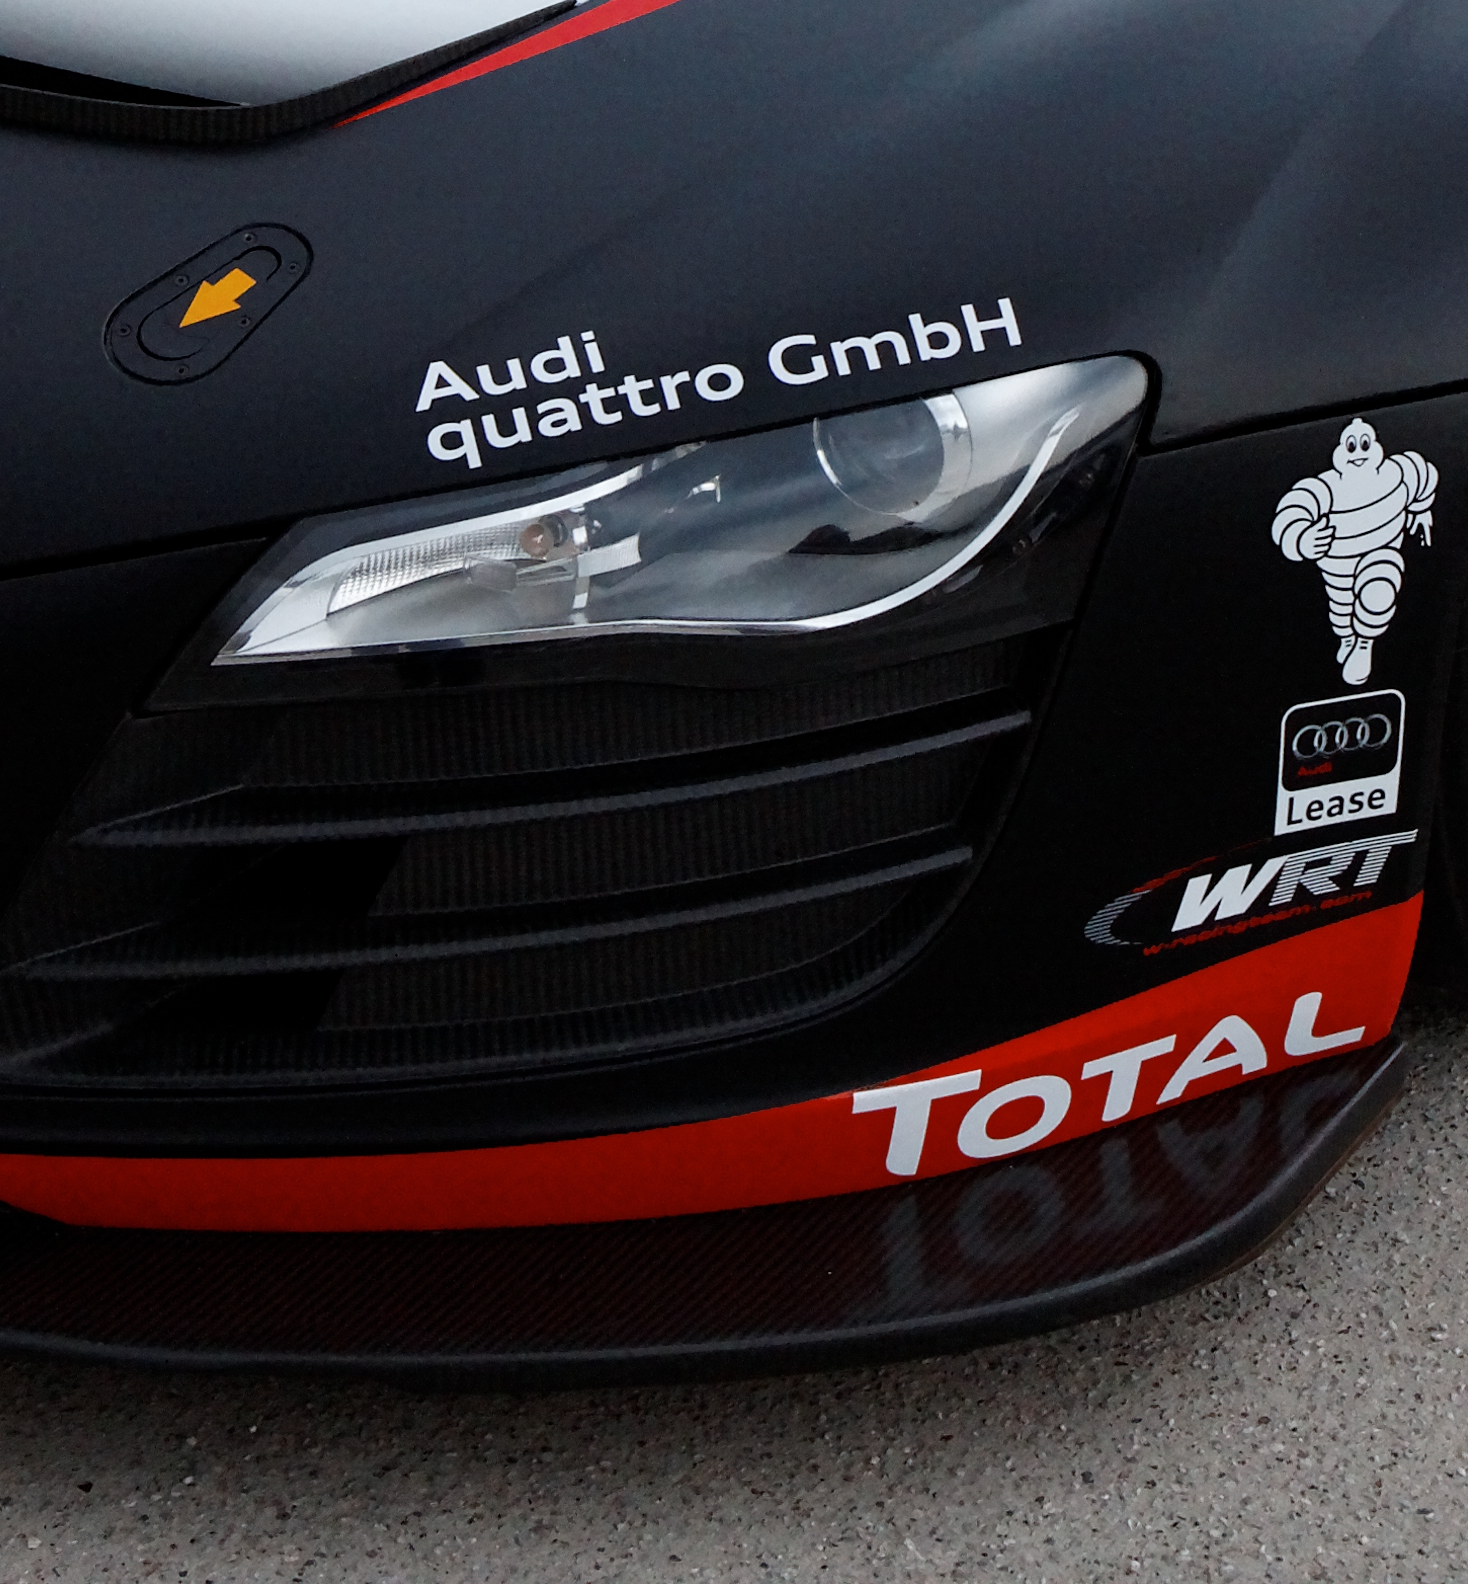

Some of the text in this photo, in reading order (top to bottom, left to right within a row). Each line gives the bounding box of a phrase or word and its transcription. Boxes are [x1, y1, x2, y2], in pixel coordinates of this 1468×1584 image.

[414, 330, 606, 413] Audi
[426, 297, 1022, 470] quattro GmbH
[1286, 788, 1386, 826] Lease
[1171, 828, 1419, 933] WRT
[851, 991, 1367, 1177] TOTAL
